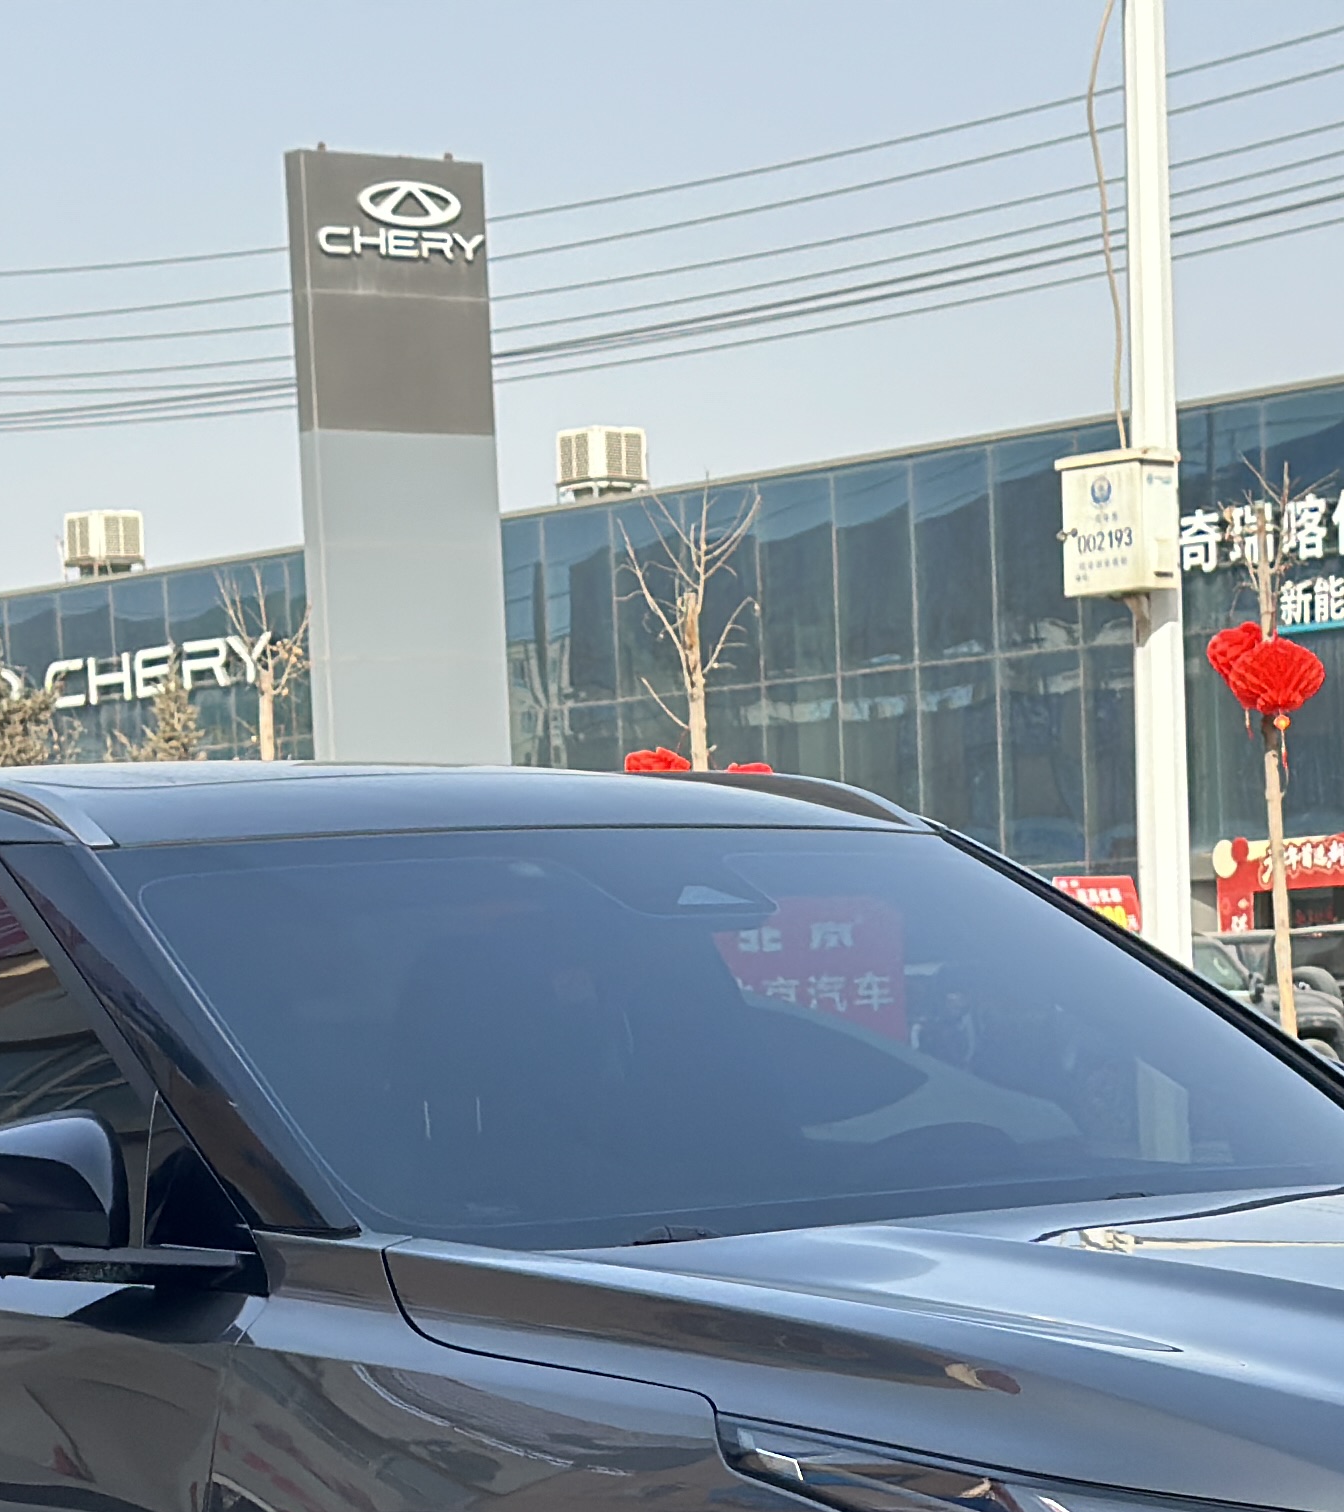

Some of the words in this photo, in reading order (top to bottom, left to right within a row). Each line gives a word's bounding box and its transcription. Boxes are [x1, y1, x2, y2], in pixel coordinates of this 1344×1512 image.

[317, 226, 484, 261] CHERY
[1077, 526, 1133, 554] 002193
[44, 631, 272, 708] CHERY
